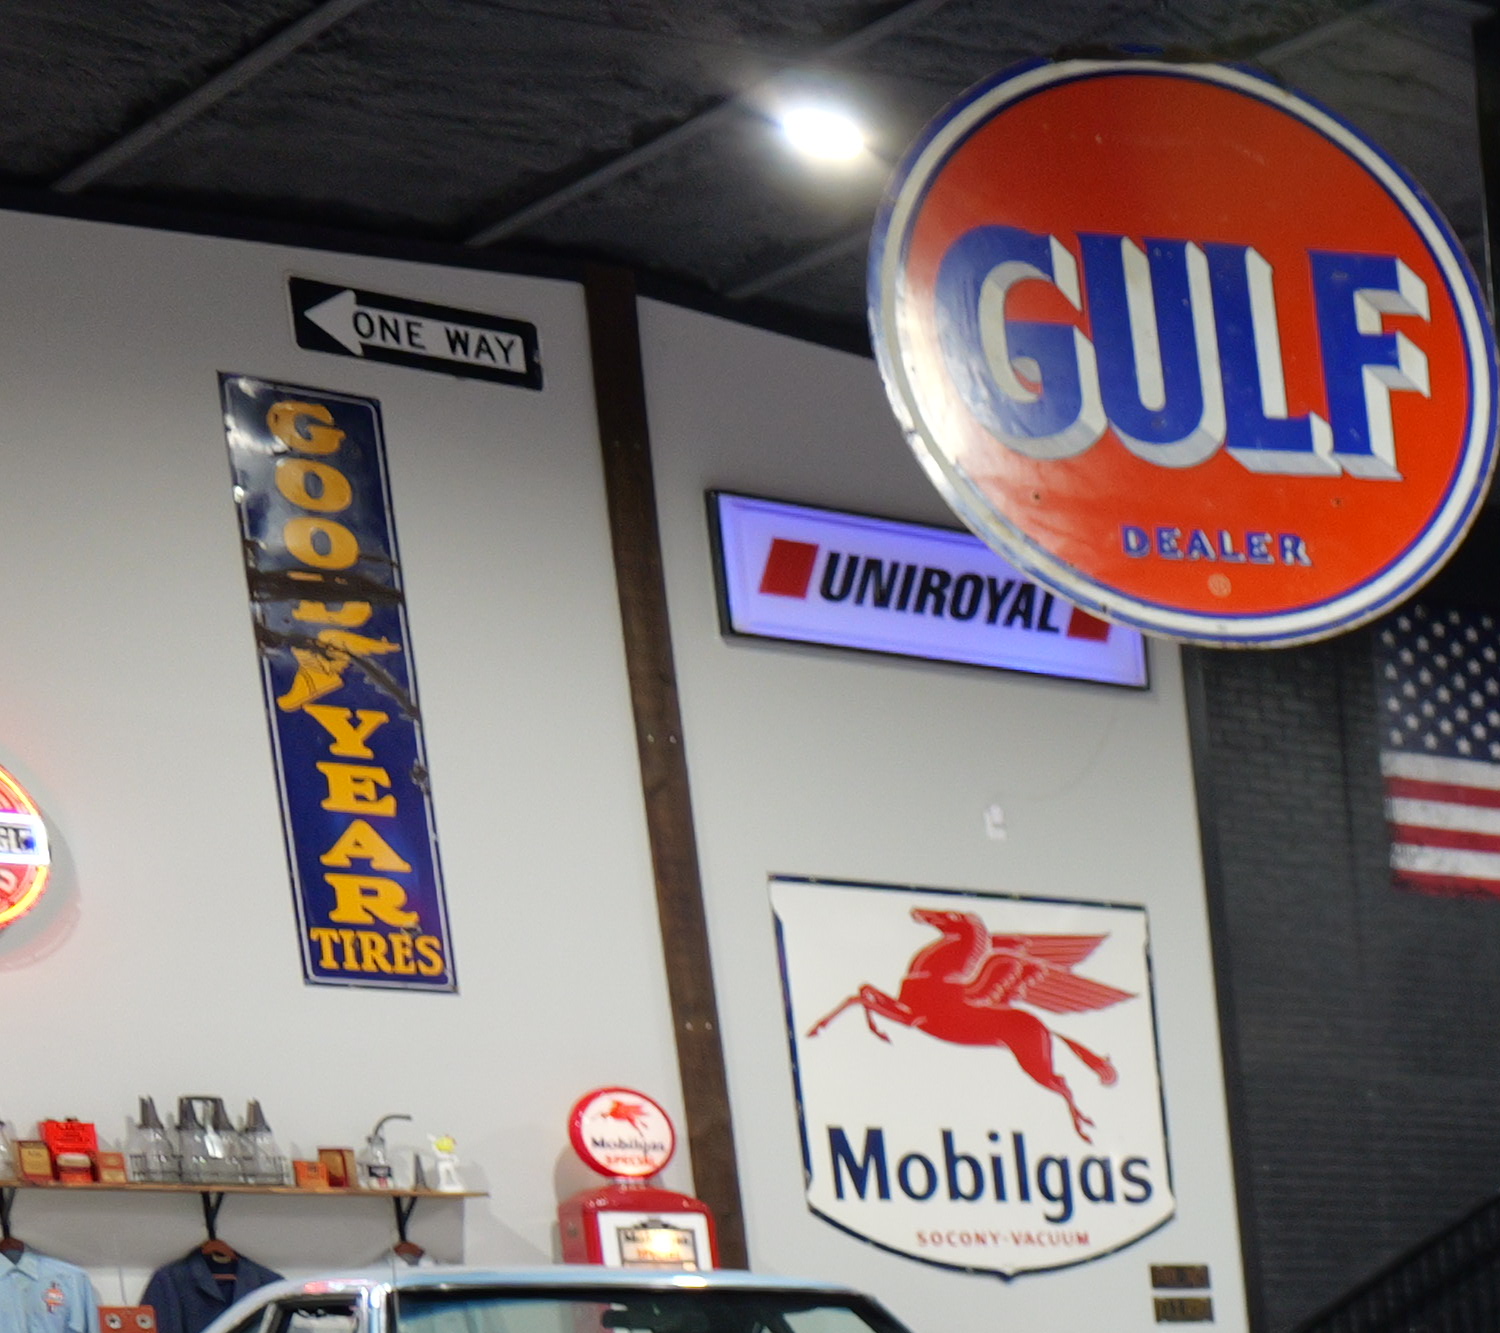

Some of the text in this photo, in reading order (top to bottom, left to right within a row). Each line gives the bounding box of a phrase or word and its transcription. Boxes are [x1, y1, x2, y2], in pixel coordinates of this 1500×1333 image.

[352, 311, 519, 367] ONE WAY
[935, 223, 1432, 482] GULF
[1121, 525, 1313, 567] DEALER
[820, 551, 1060, 635] UNIROYAL
[310, 927, 444, 978] TIRES
[827, 1126, 1155, 1224] Mobilgas
